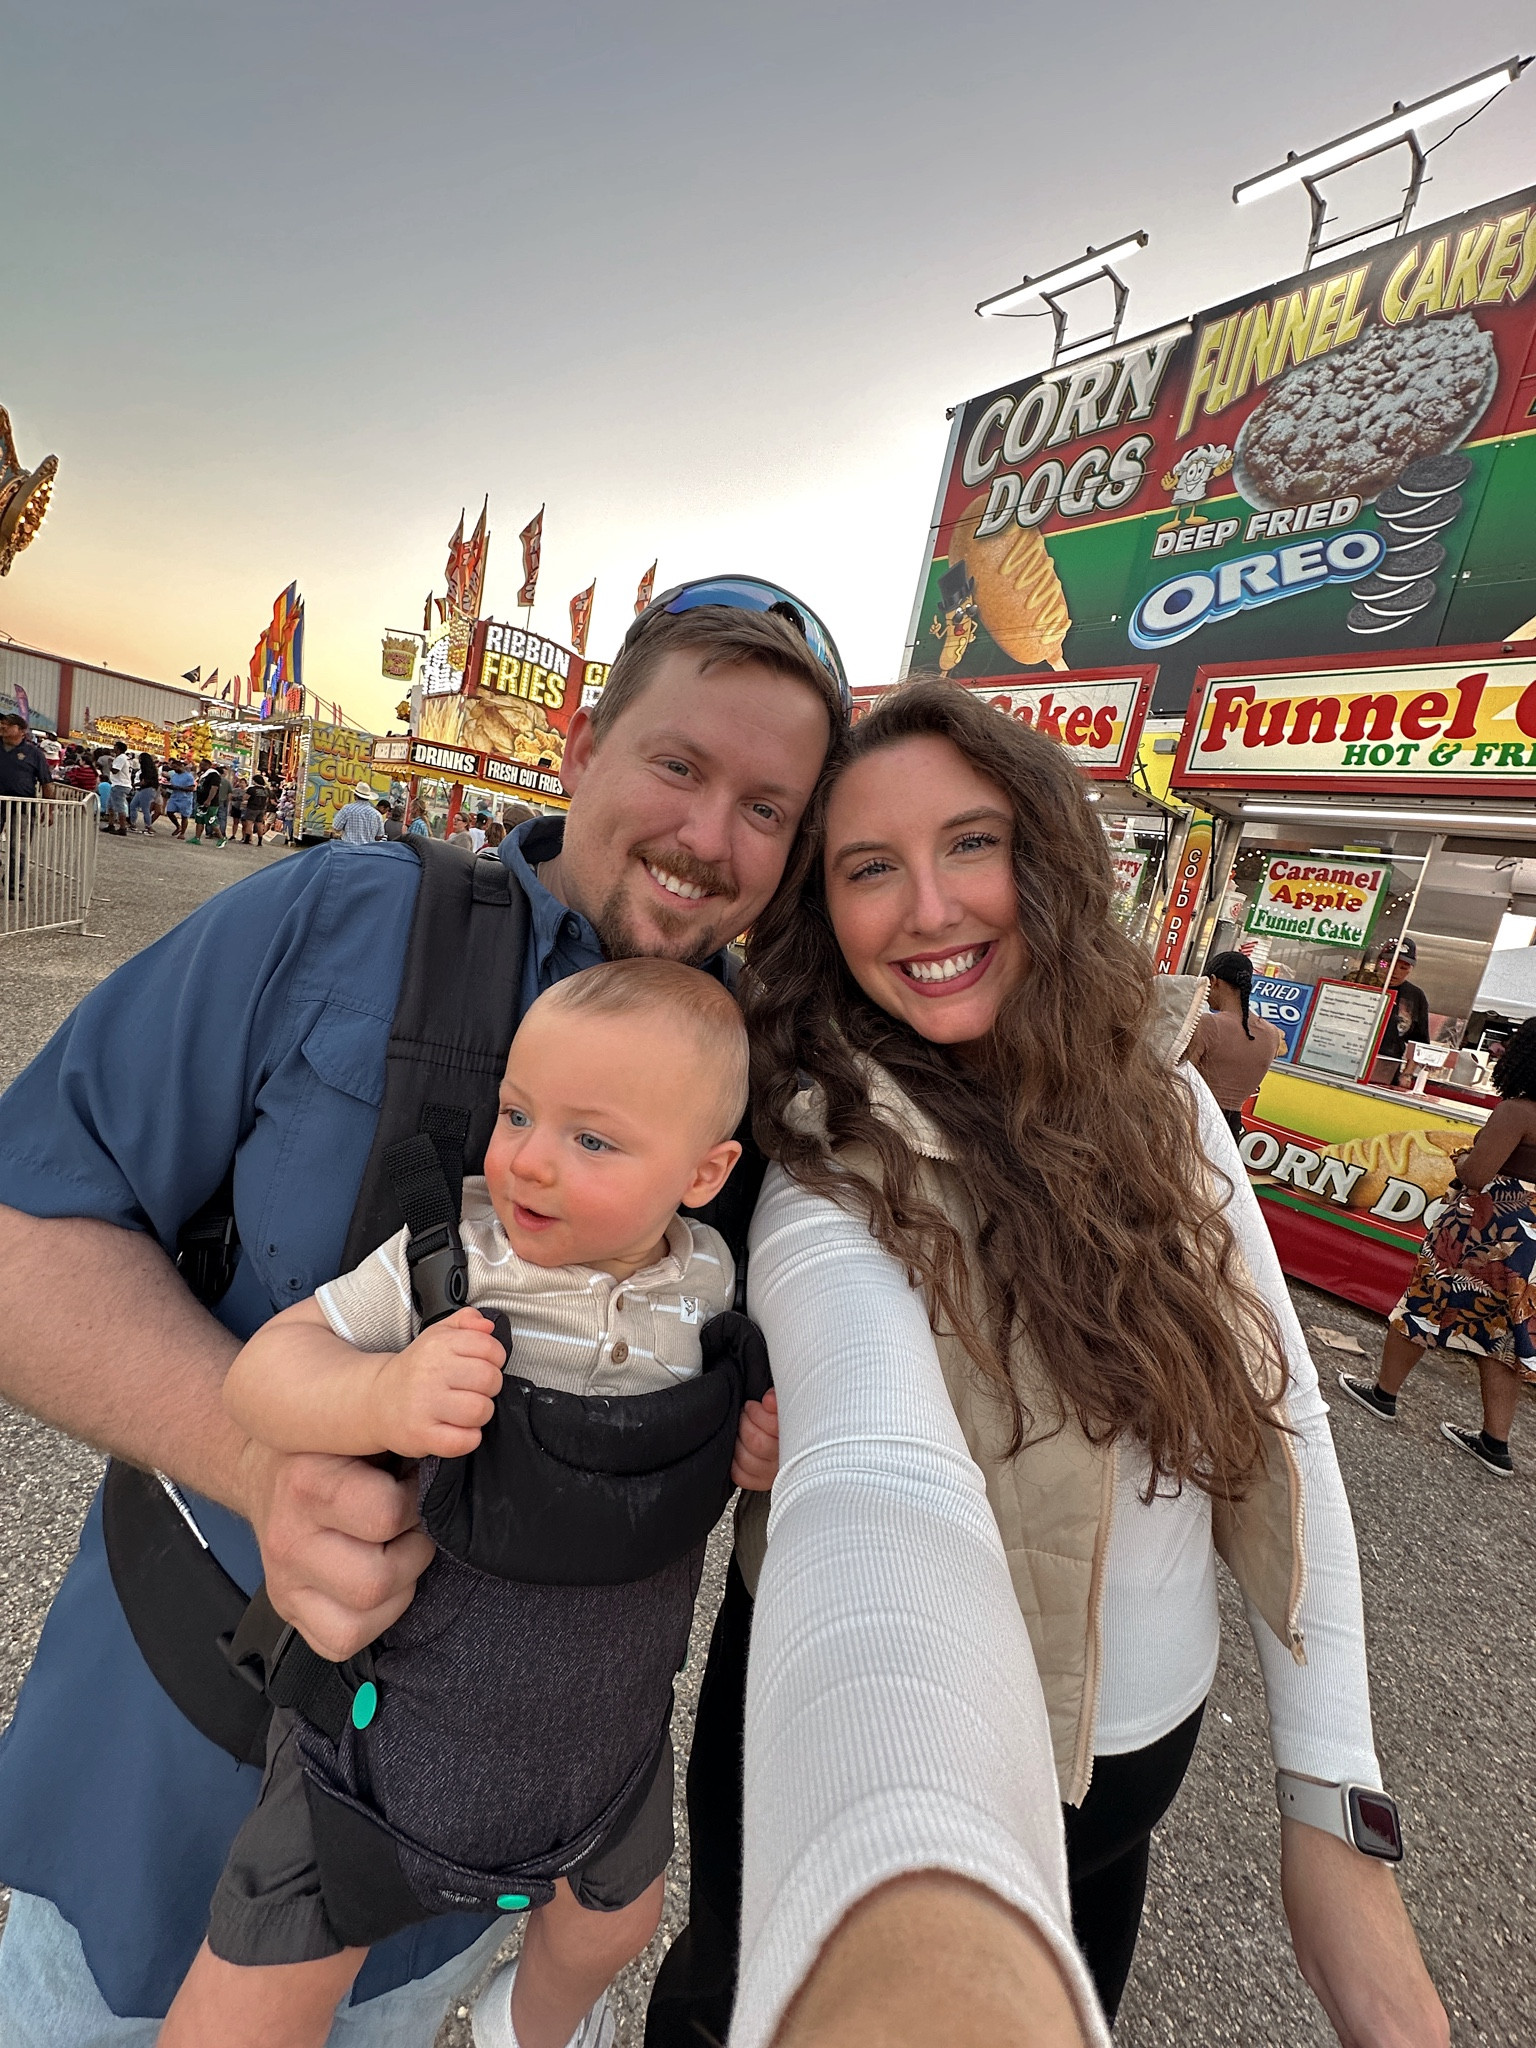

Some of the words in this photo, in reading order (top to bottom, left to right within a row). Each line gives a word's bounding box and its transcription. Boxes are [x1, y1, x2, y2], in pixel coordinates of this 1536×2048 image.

[1177, 265, 1369, 439] FUNNEL
[1384, 206, 1536, 324] CAKES
[963, 338, 1179, 487] CORN
[974, 433, 1153, 538] DOGS
[1153, 519, 1240, 557] DEEP
[1246, 496, 1361, 541] FRIED
[1140, 532, 1382, 632] OREO
[485, 625, 570, 677] RIBBON
[480, 651, 566, 709] FRIES
[1201, 673, 1489, 752] Funnel
[313, 730, 372, 763] WATE
[414, 744, 476, 774] DRINKS
[1341, 743, 1419, 766] HOT
[1428, 743, 1462, 766] &
[319, 759, 371, 786] GUN
[488, 761, 519, 784] FRESH
[519, 769, 538, 788] CUT
[538, 773, 563, 796] FRIES
[318, 785, 355, 811] FU
[1175, 849, 1202, 908] COLD
[1269, 861, 1381, 891] Caramel
[1270, 885, 1363, 912] Apple
[1157, 917, 1183, 975] DRIN
[1254, 909, 1316, 935] Funnel
[1317, 919, 1363, 941] Cake
[1249, 1000, 1301, 1022] REO
[1251, 980, 1301, 1001] FRIED
[1238, 1131, 1367, 1204] ORN
